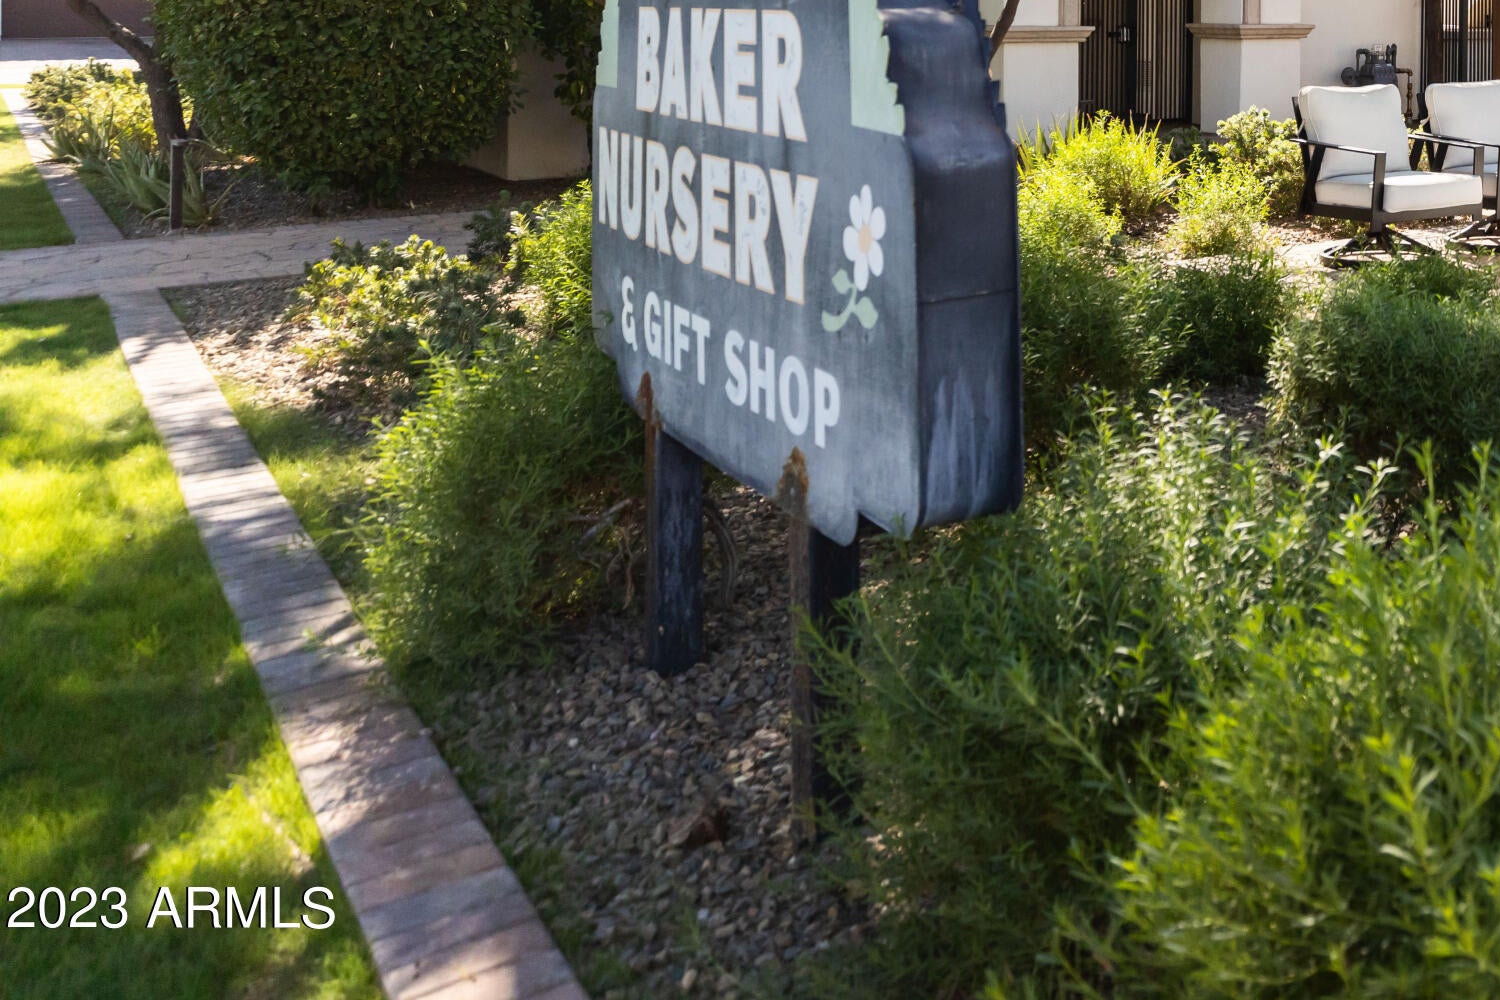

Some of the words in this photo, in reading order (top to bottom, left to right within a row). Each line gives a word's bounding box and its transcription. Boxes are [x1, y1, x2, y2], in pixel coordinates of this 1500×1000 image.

[636, 6, 807, 142] BAKER
[598, 126, 818, 304] NURSERY
[621, 275, 638, 353] &
[643, 291, 711, 385] GIFT
[724, 329, 840, 449] SHOP
